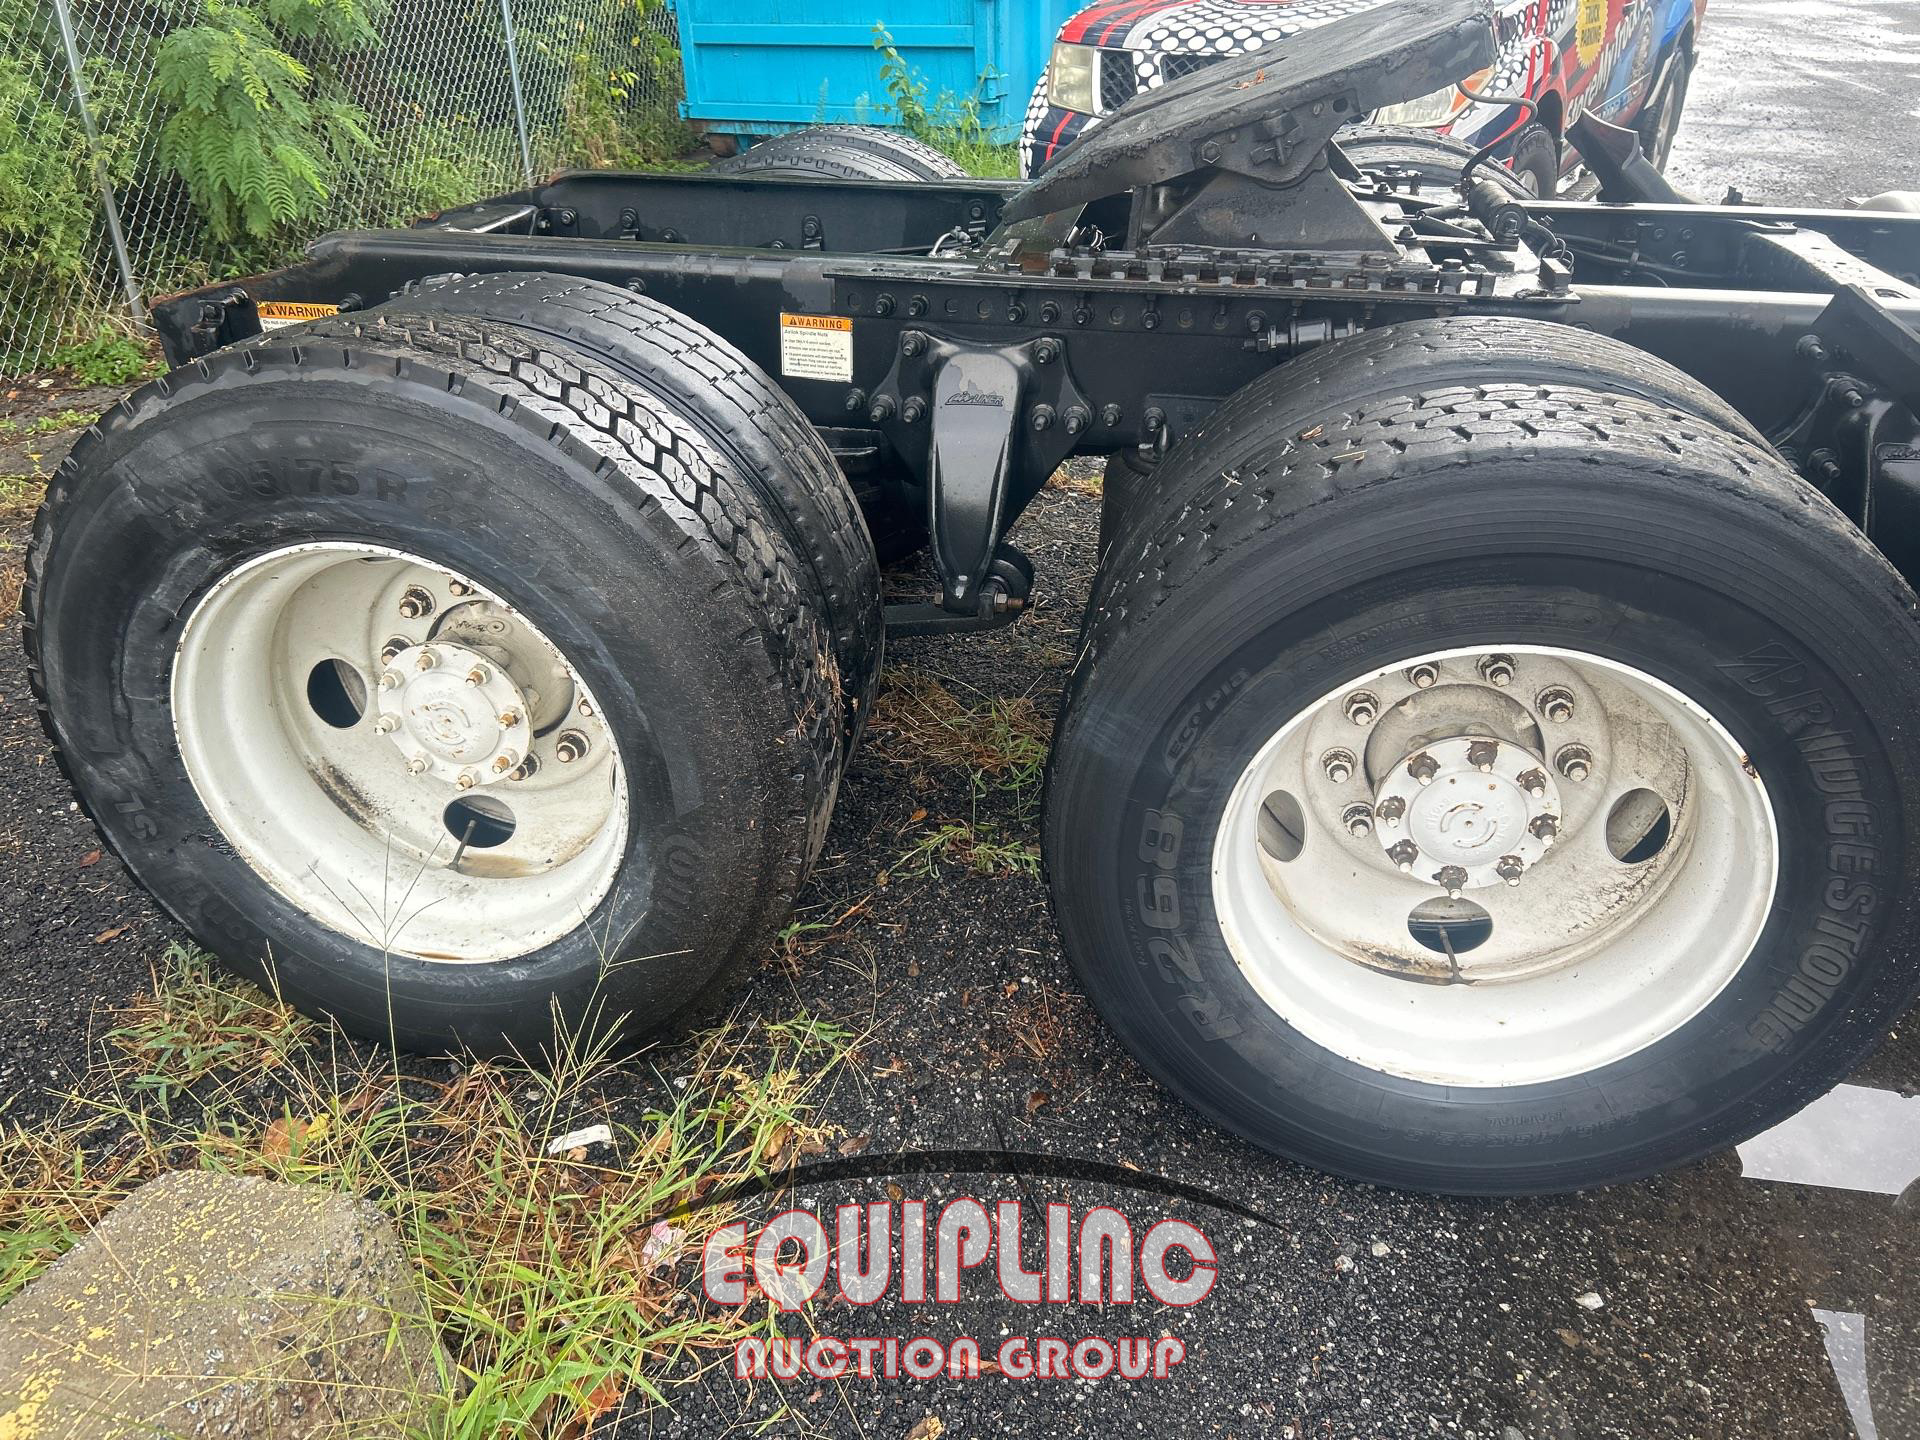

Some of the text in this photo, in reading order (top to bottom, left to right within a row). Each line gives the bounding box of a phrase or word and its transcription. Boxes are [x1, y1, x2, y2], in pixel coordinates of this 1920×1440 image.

[276, 305, 334, 317] WARNING
[797, 316, 842, 329] WARNING
[1713, 640, 1885, 1057] BRIDGESTONE
[1137, 808, 1246, 1042] R268
